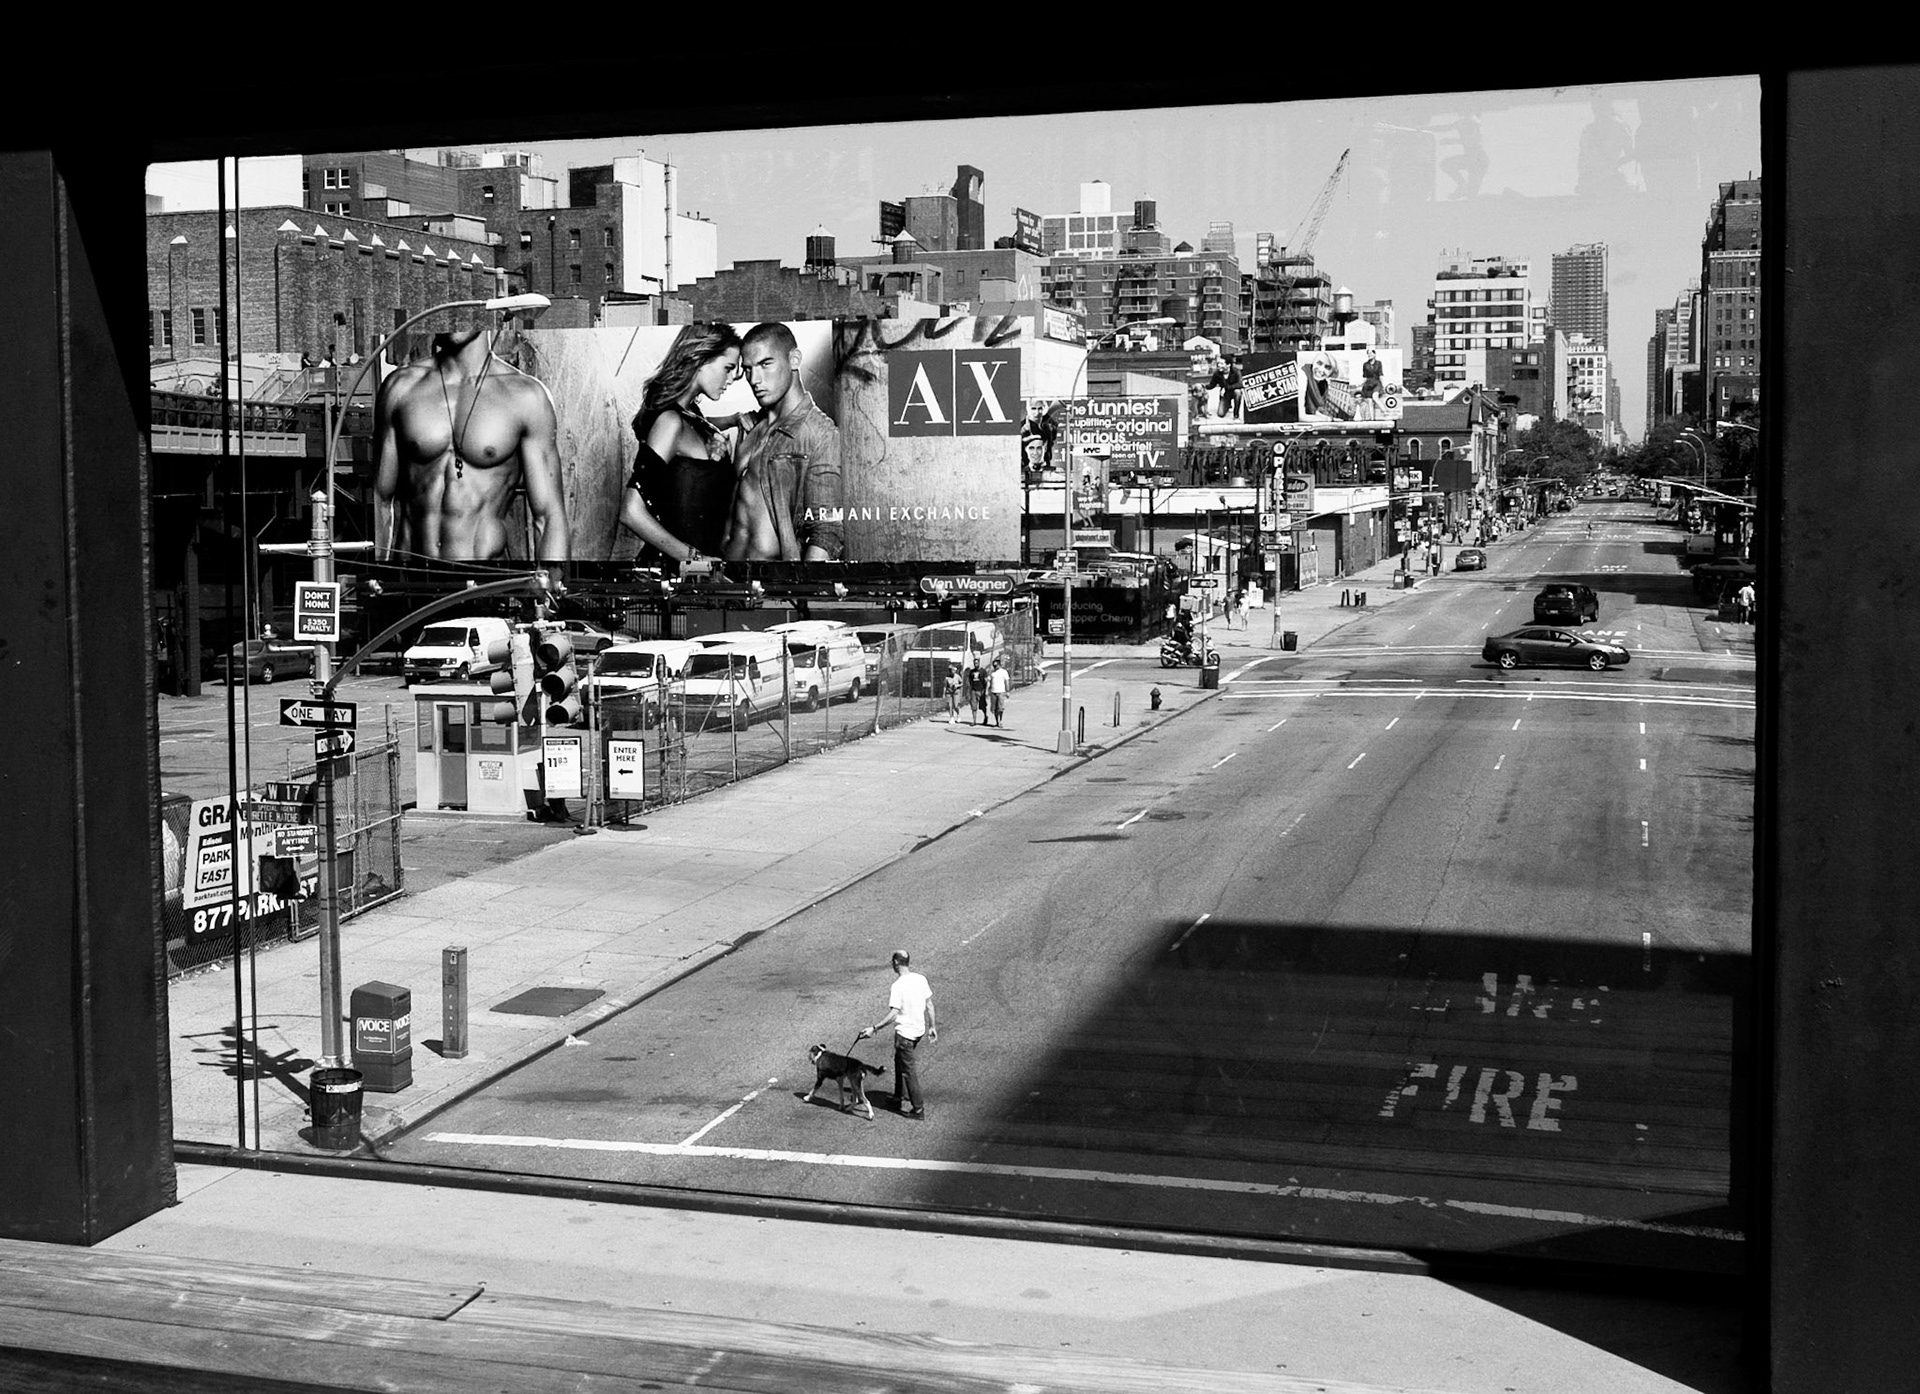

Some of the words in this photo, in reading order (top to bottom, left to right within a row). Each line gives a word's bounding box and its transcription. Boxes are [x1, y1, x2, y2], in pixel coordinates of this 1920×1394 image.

[1243, 365, 1296, 388] CONVERSE
[1247, 386, 1267, 405] ONE
[1276, 376, 1298, 395] STAR
[1087, 399, 1160, 416] funniest
[1116, 418, 1172, 435] original
[804, 506, 881, 521] ARMANI
[890, 506, 990, 521] EXCHANGE
[929, 577, 953, 590] Van
[955, 577, 1009, 592] Wagner
[304, 591, 331, 600] DON'T
[304, 600, 330, 609] HONK
[1050, 601, 1103, 613] Intrducing
[307, 618, 327, 626] $350
[1100, 613, 1134, 625] Cherry
[302, 625, 331, 633] PENALTY
[1571, 630, 1629, 638] ANE
[291, 708, 314, 719] ONE
[324, 709, 347, 721] WAY
[613, 746, 638, 754] ENTER
[267, 784, 278, 800] W
[286, 785, 301, 801] 17
[287, 829, 314, 837] STANDING
[281, 837, 310, 846] ANYTIME
[202, 849, 231, 865] PARK
[200, 868, 230, 884] FAST
[359, 1020, 390, 1032] VOICE
[1378, 1063, 1578, 1132] FIRE
